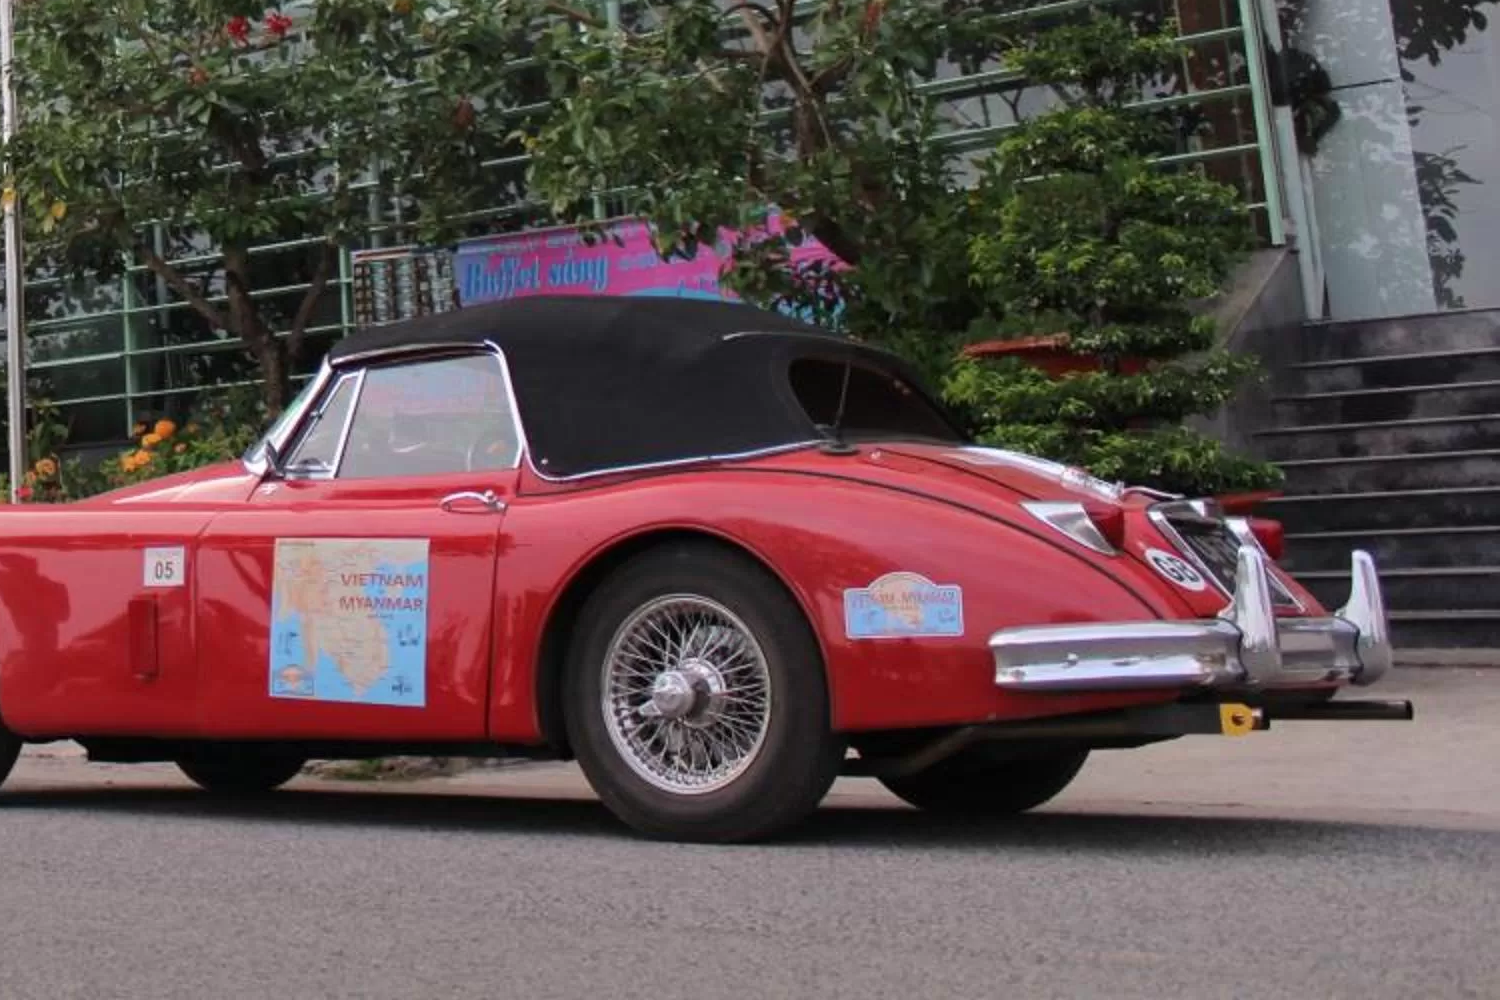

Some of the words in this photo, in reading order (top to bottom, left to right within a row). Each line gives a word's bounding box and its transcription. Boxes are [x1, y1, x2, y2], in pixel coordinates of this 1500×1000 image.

[464, 255, 541, 299] Buffet
[155, 560, 174, 580] 05
[1152, 555, 1200, 583] GB
[341, 573, 424, 588] VIETNAM
[339, 596, 423, 612] MYANMAR
